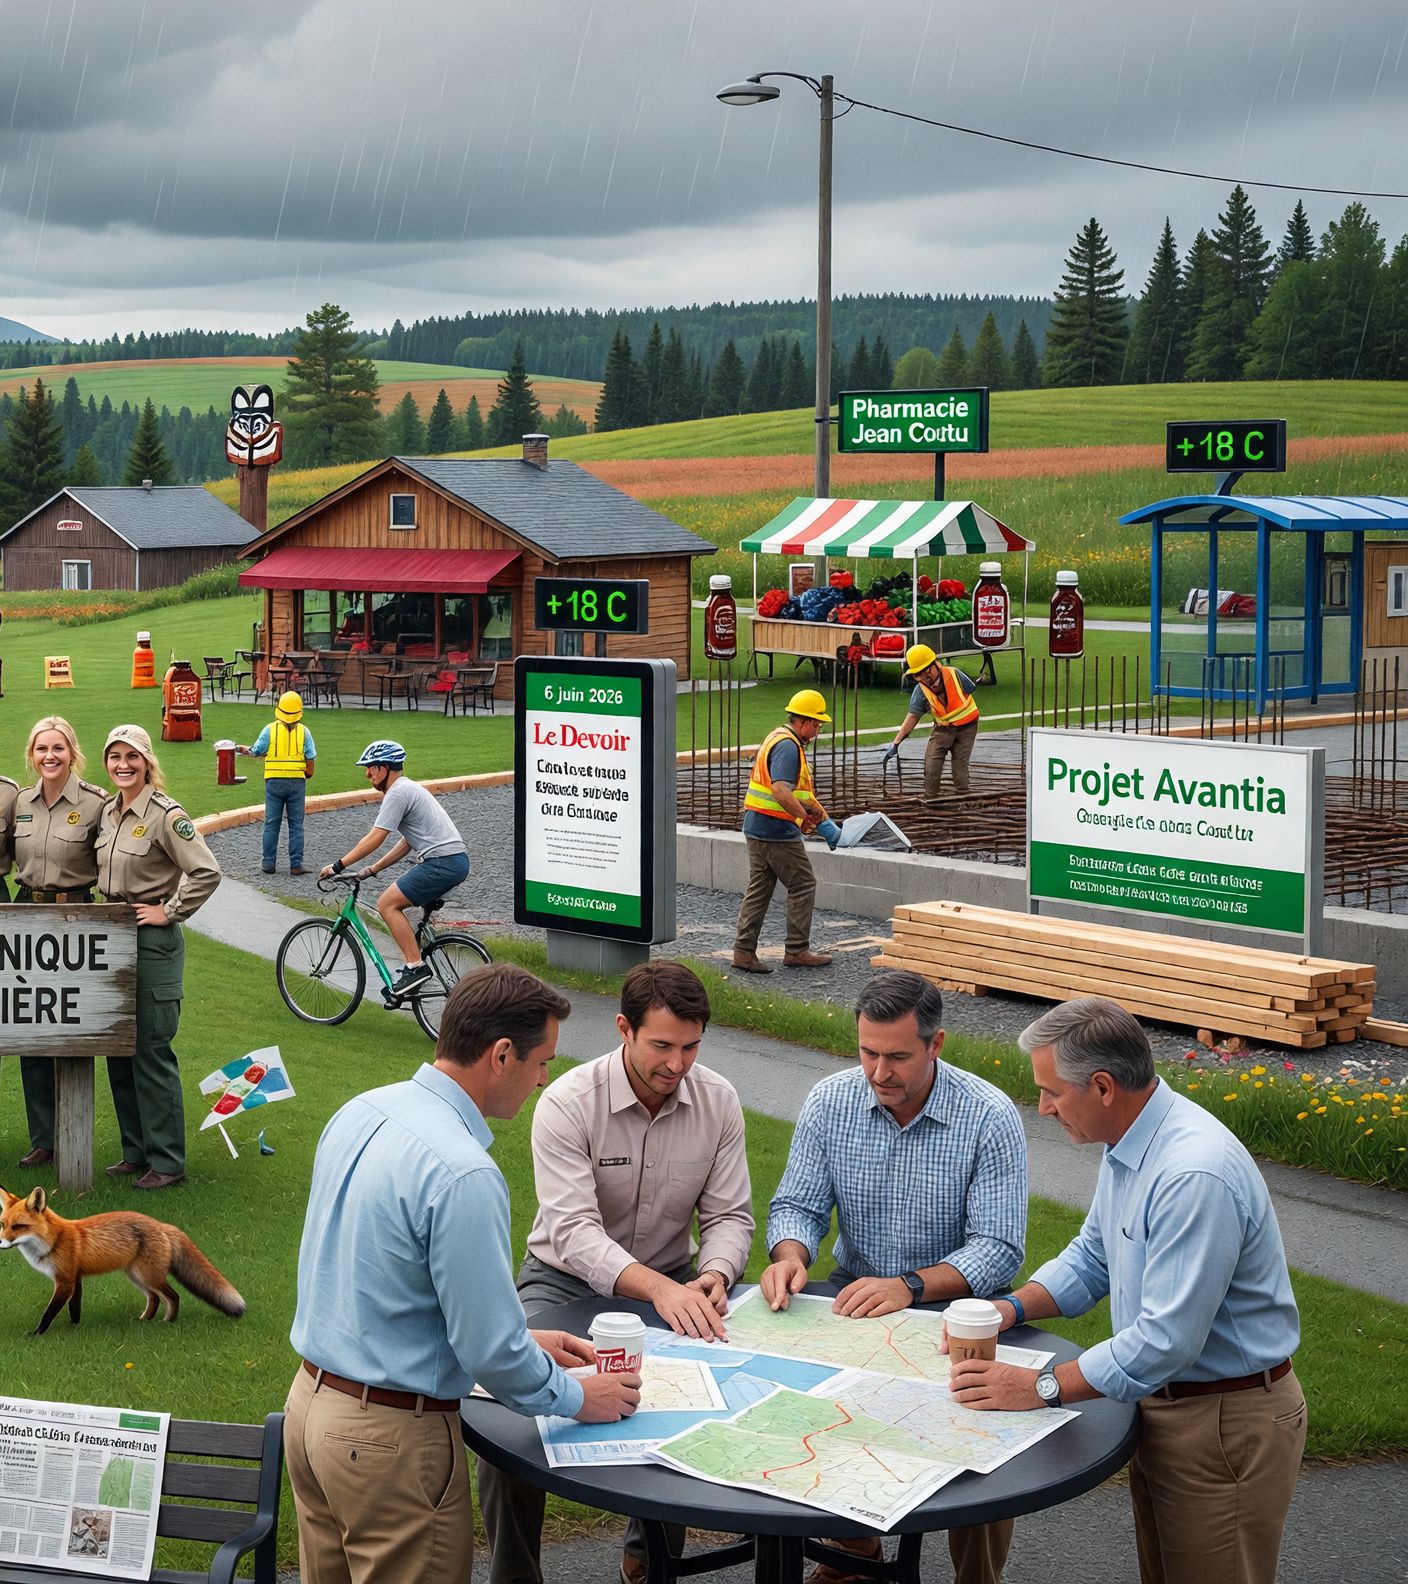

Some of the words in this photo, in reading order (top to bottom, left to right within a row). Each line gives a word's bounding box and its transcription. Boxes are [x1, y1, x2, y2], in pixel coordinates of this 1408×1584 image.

[852, 397, 969, 419] Pharmacie
[851, 423, 902, 444] Jean
[1176, 431, 1234, 461] +18
[1244, 431, 1264, 461] C
[546, 590, 598, 622] +18
[607, 591, 627, 622] C
[544, 685, 553, 700] 6
[556, 686, 584, 705] juin
[589, 688, 623, 704] 2026
[533, 723, 557, 746] Le
[560, 724, 630, 751] Devoir
[1048, 757, 1144, 806] Projet
[1153, 768, 1286, 815] Avantia
